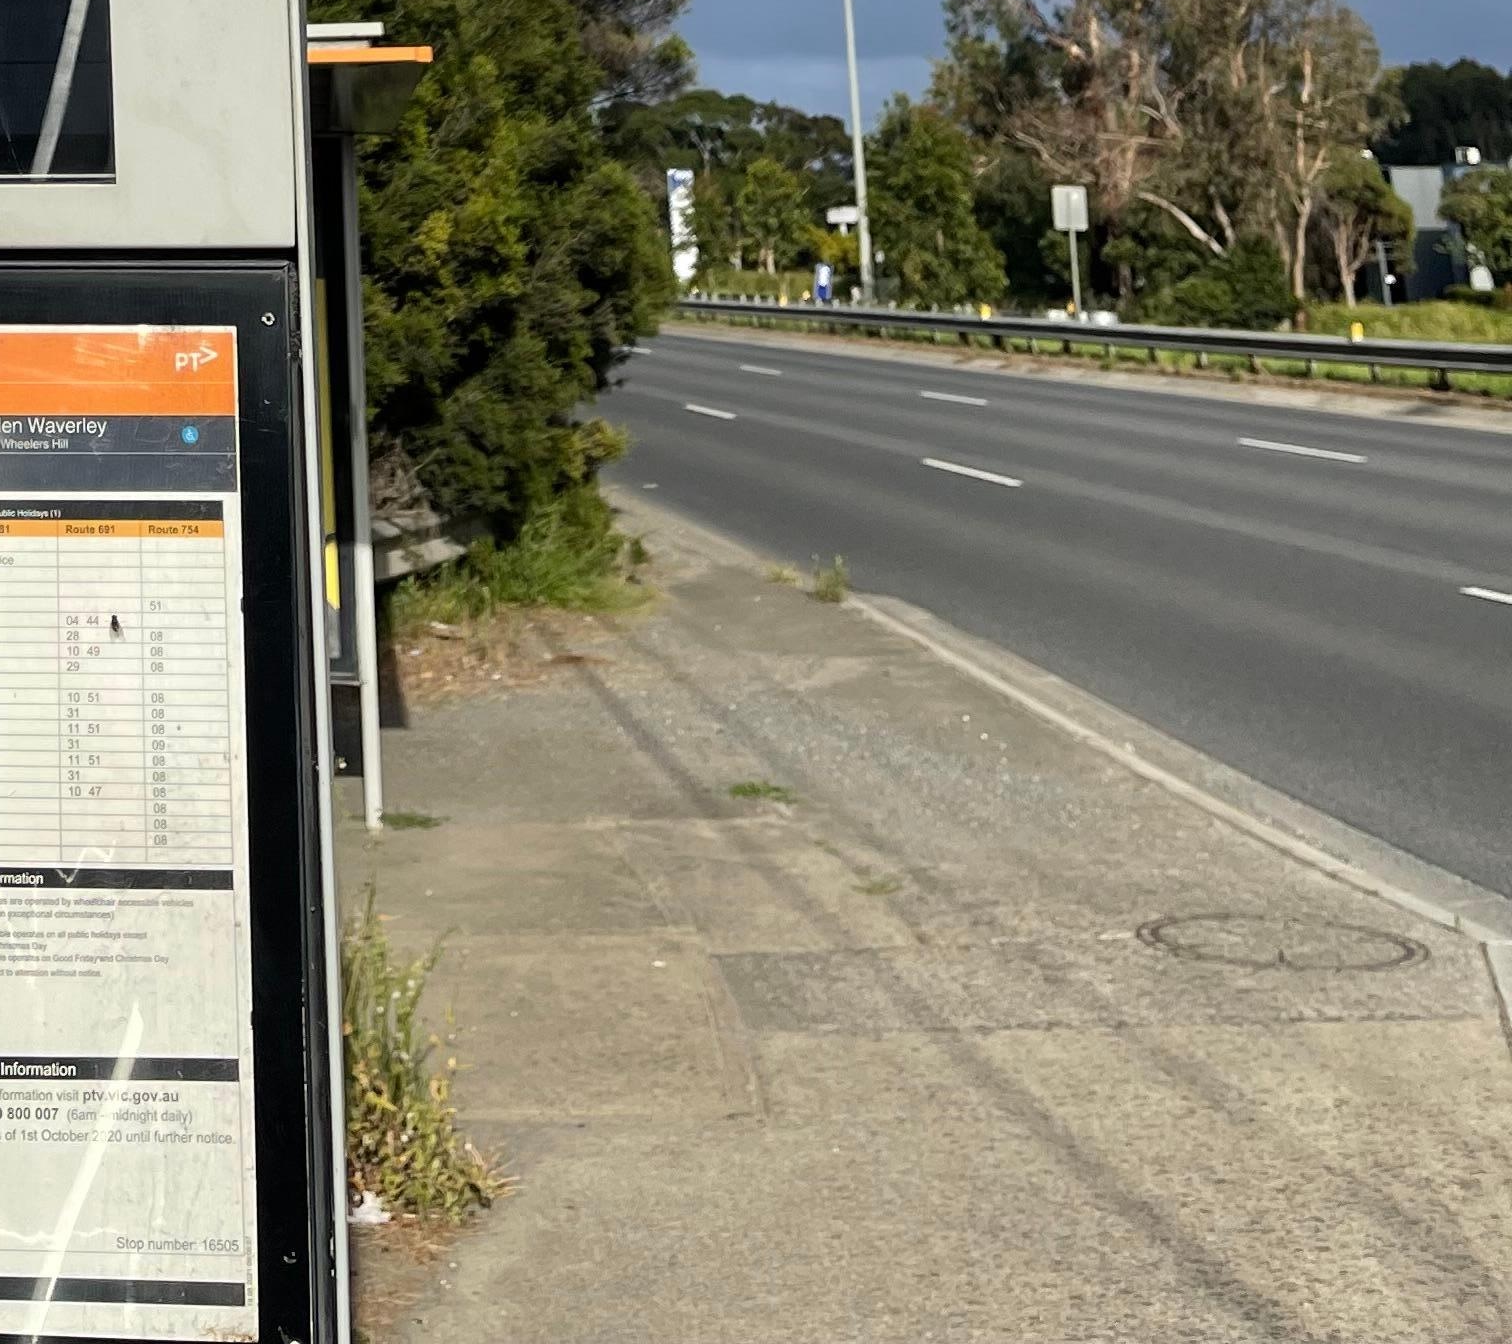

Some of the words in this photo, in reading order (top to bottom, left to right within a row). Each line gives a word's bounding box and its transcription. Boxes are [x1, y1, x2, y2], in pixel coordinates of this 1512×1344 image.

[29, 418, 107, 437] Waverley
[0, 439, 49, 449] Wheelers
[52, 439, 68, 449] Hill
[18, 510, 48, 518] Holidays
[50, 510, 61, 518] (1)
[66, 526, 95, 534] Route
[98, 526, 115, 534] 691
[148, 526, 178, 534] Route
[182, 526, 199, 534] 754
[68, 693, 80, 702] 10
[88, 693, 100, 702] 51
[151, 694, 164, 703] 08
[61, 897, 71, 907] by
[1, 1063, 76, 1077] Information
[57, 1090, 79, 1101] visit
[7, 1108, 31, 1119] 800
[35, 1108, 58, 1120] 007
[67, 1109, 96, 1122] (6am
[161, 1111, 192, 1123] daily)
[5, 1130, 17, 1141] of
[21, 1130, 39, 1141] 1st
[42, 1130, 88, 1142] October
[92, 1131, 122, 1142] 220
[126, 1132, 149, 1142] until
[154, 1132, 192, 1143] further
[196, 1133, 236, 1144] notice.
[116, 1237, 144, 1250] Stop
[203, 1240, 239, 1251] 16505
